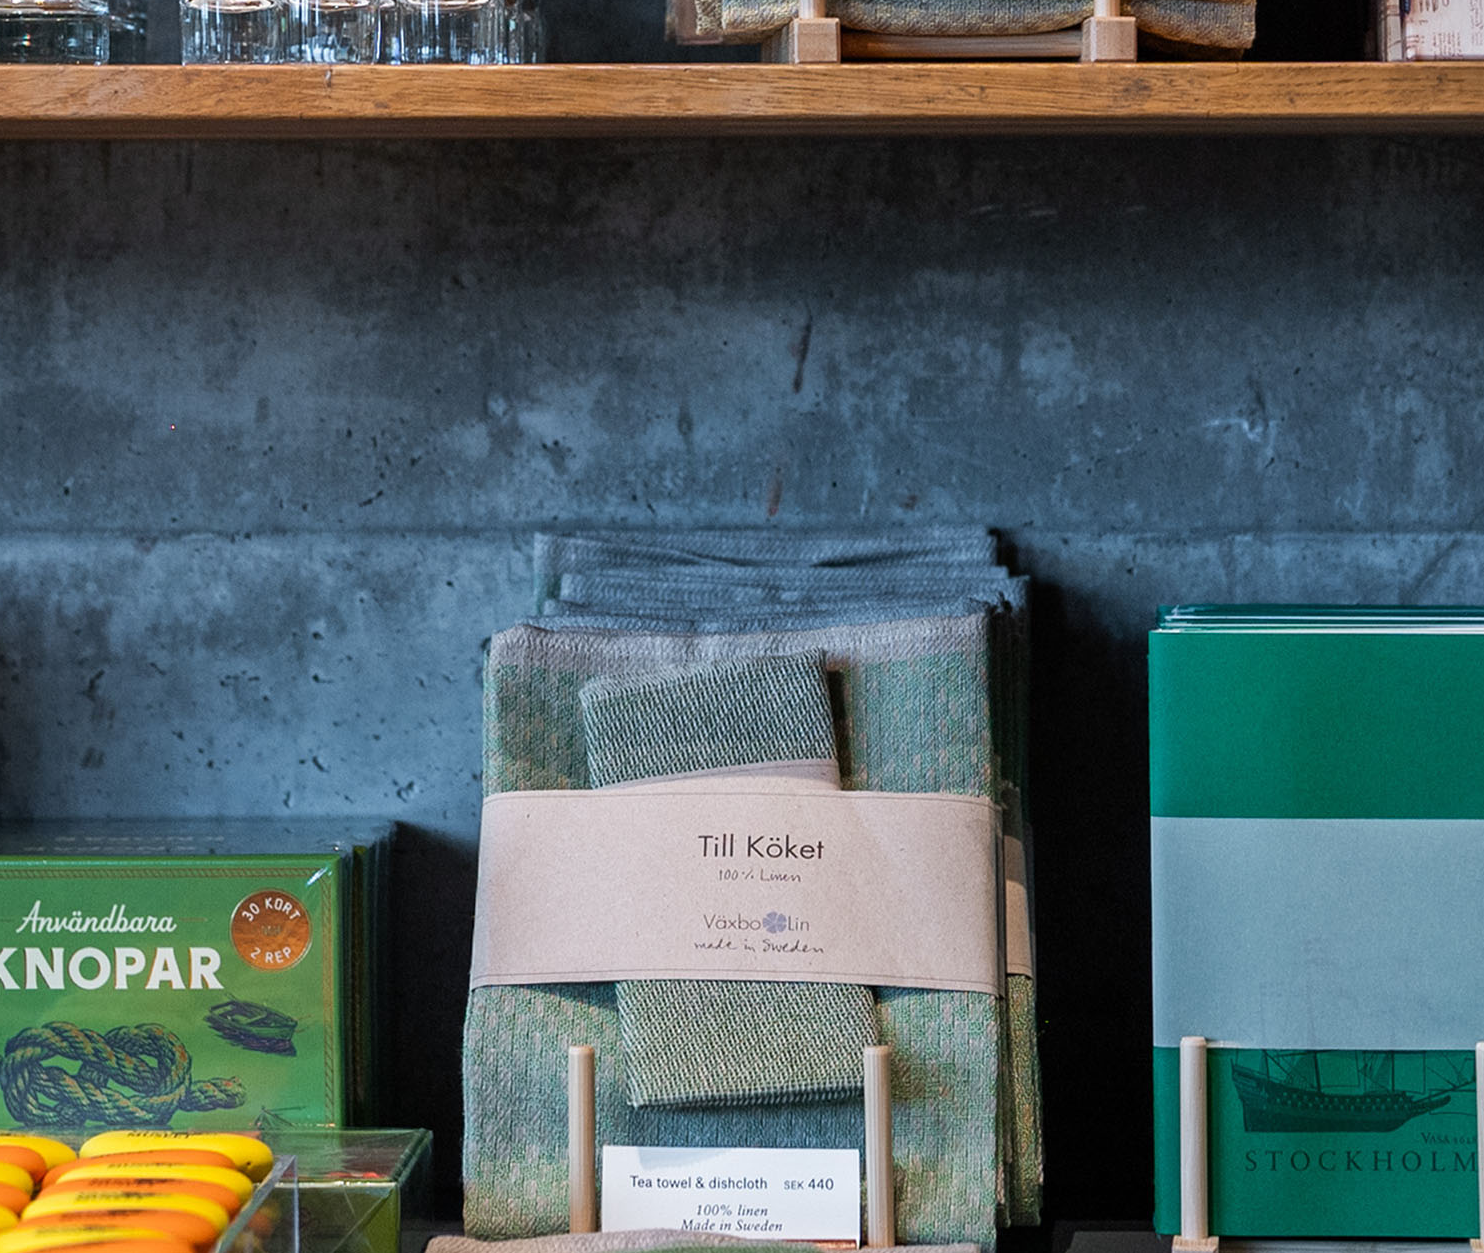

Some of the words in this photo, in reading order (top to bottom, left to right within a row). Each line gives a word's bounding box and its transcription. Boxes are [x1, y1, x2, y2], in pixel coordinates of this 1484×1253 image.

[698, 833, 734, 857] Till
[747, 834, 825, 859] Köket
[760, 868, 801, 882] Linen
[15, 900, 177, 934] Användbara
[241, 903, 261, 922] 30
[264, 897, 301, 921] KORT
[703, 913, 762, 930] Växbo
[788, 916, 810, 931] Lin
[694, 939, 737, 950] made
[744, 939, 755, 952] in
[762, 938, 824, 953] Sweden
[250, 947, 261, 961] 2
[265, 946, 292, 964] REP
[1421, 1132, 1450, 1144] VASA
[1245, 1149, 1477, 1172] STOCKHOLM
[630, 1175, 652, 1188] Tea
[656, 1177, 691, 1189] towel
[695, 1176, 704, 1189] &
[709, 1177, 767, 1190] dishcloth
[784, 1181, 803, 1190] SEK
[808, 1178, 834, 1190] 440
[697, 1204, 732, 1216] 100%
[737, 1204, 768, 1217] linen
[681, 1220, 715, 1231] Made
[720, 1220, 731, 1231] in
[735, 1220, 783, 1232] Sweden
